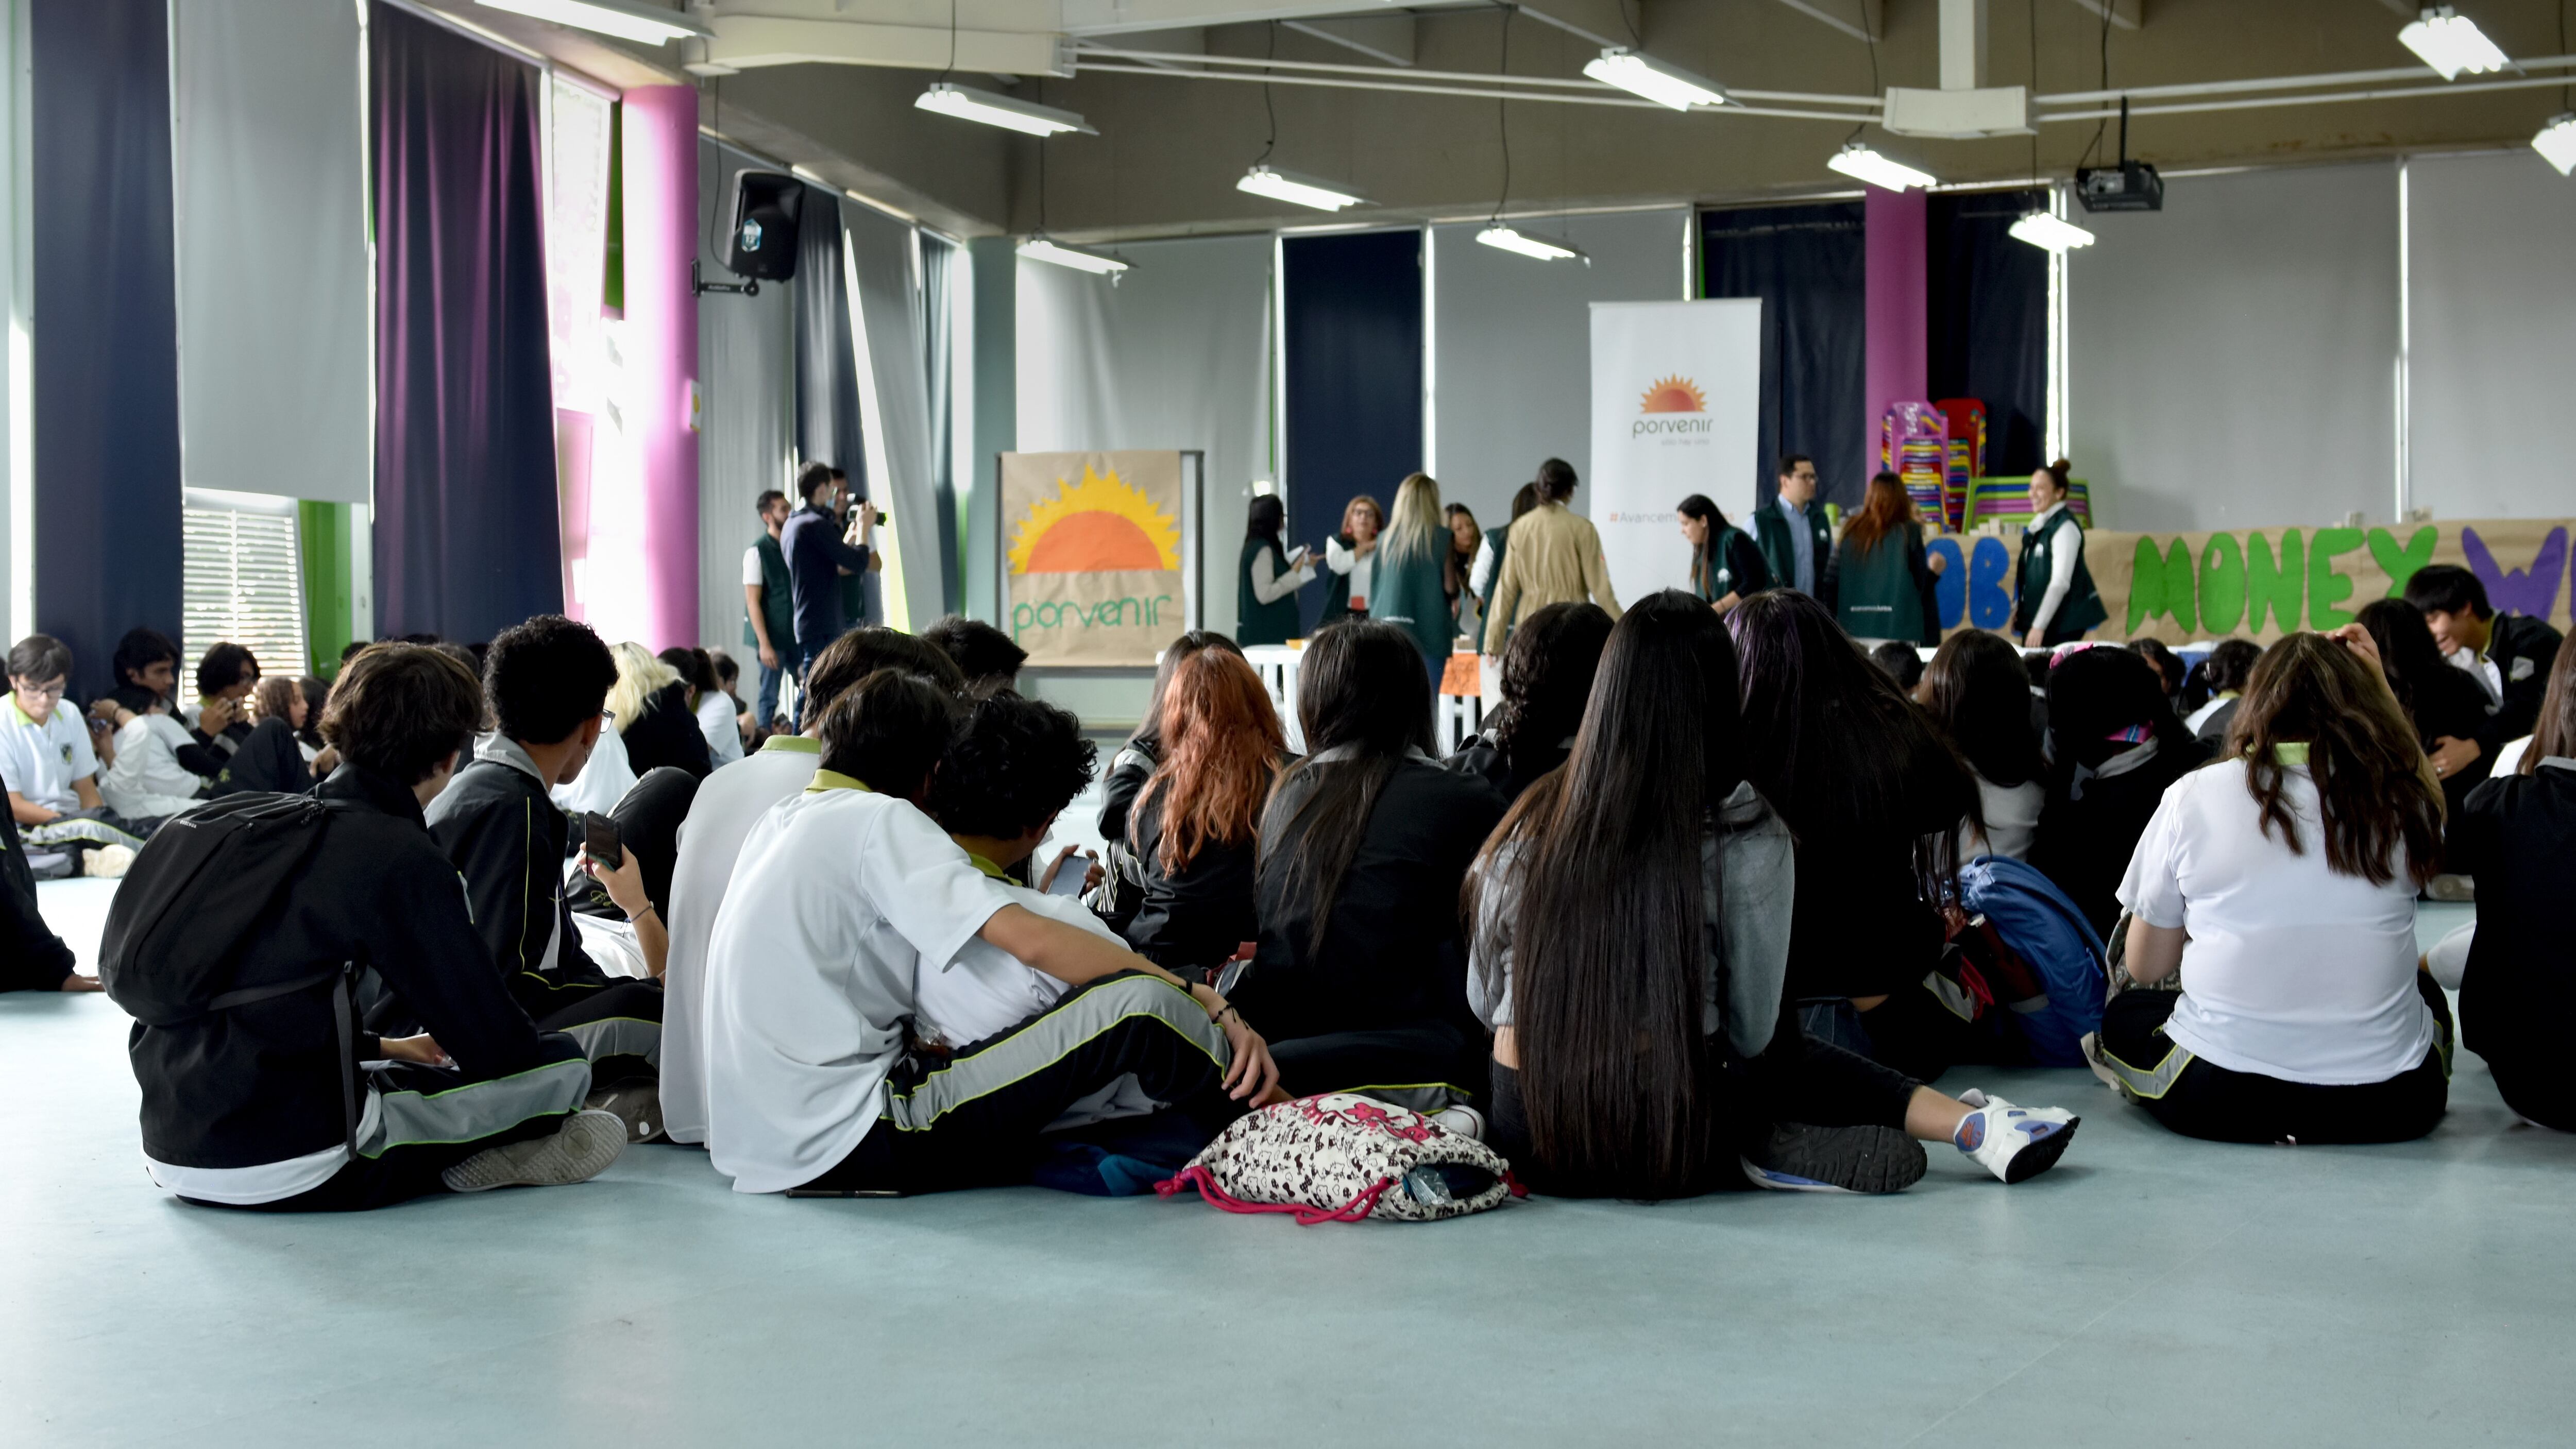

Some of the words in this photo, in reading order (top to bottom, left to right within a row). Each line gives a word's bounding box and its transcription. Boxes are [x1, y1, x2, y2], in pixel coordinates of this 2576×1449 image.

[1632, 418, 1714, 438] porvenir
[1610, 511, 1679, 523] #Avancem
[1926, 537, 2022, 637] OB
[2126, 524, 2438, 636] MONEY
[2461, 525, 2576, 624] W
[1013, 594, 1172, 645] porvenir
